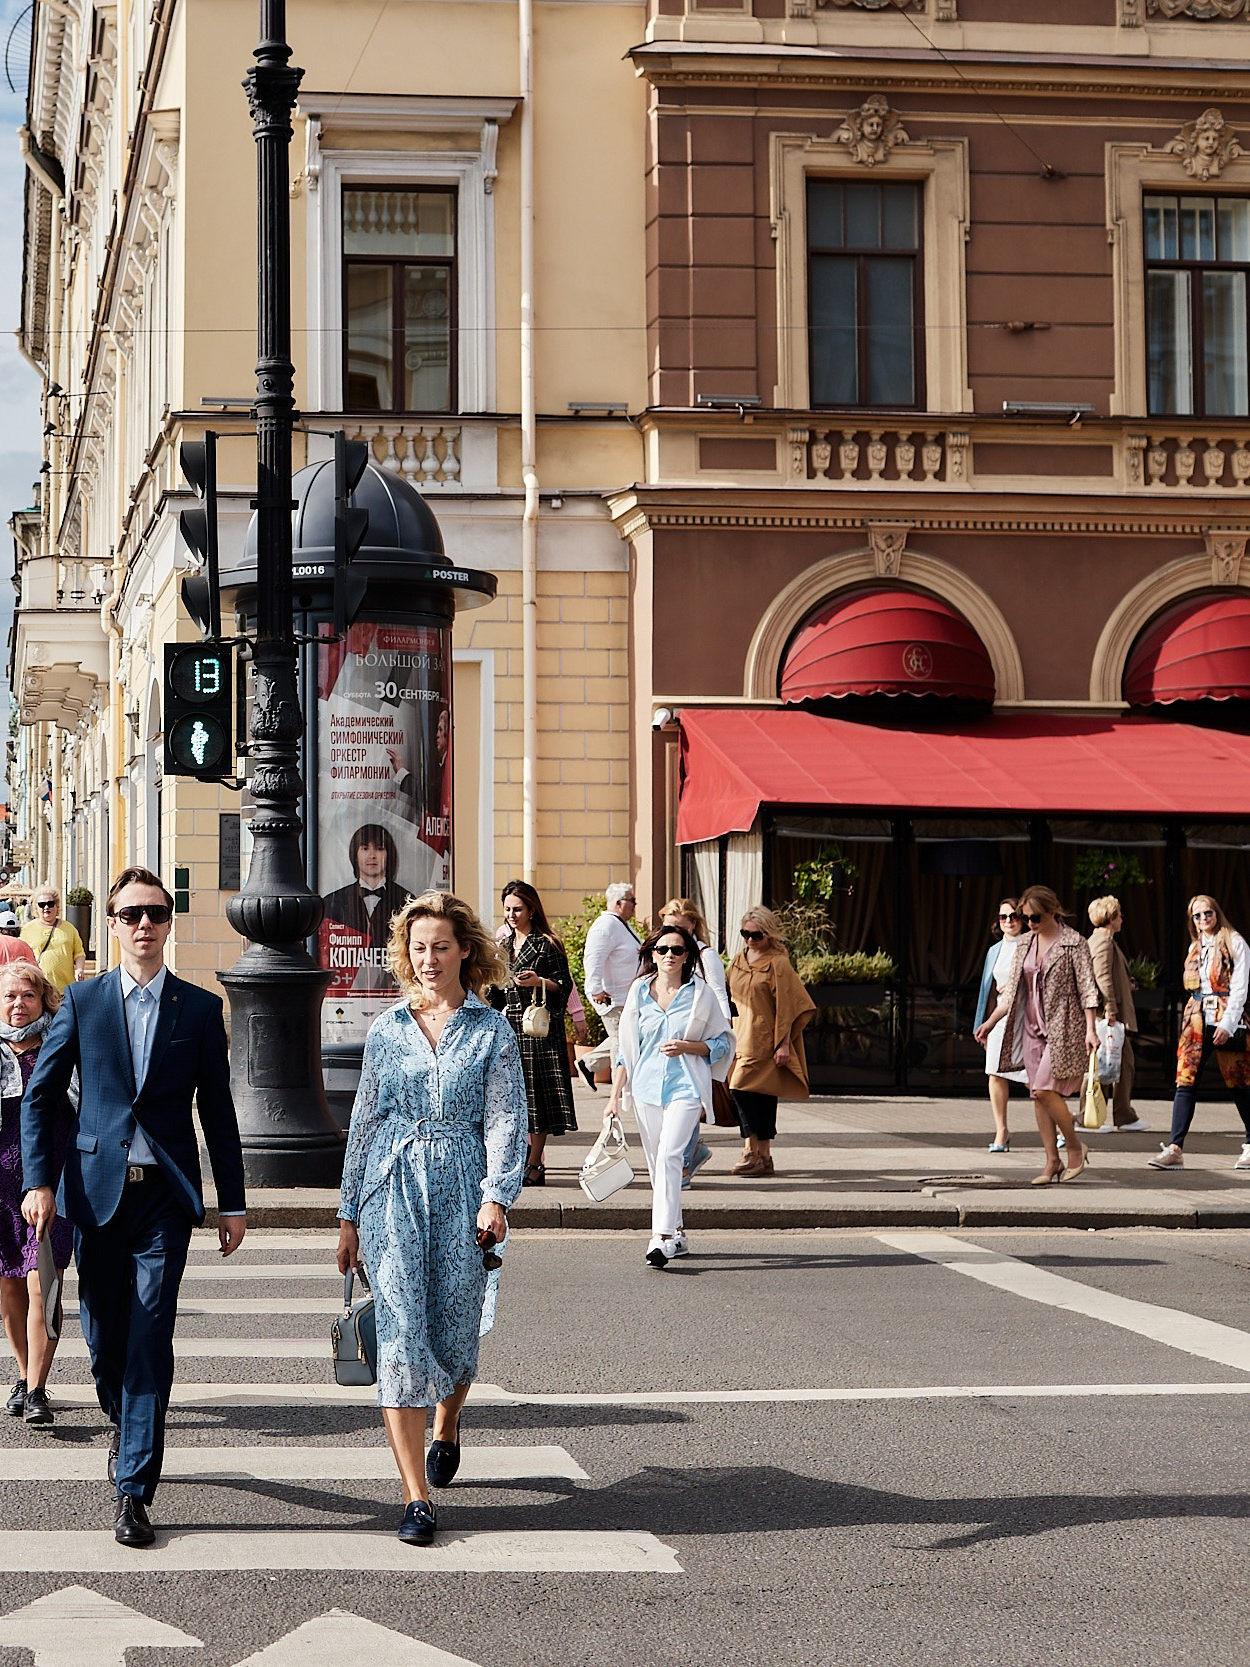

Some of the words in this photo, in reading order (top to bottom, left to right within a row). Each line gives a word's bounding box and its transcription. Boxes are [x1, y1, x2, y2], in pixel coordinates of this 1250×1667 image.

[292, 566, 325, 576] L0016
[432, 569, 469, 582] POSTER
[383, 635, 435, 647] ФИЛАРМОНИЯ
[356, 653, 431, 669] БОЛЬШОЙ
[194, 658, 221, 694] 13
[343, 691, 372, 699] СУББОТА
[374, 681, 398, 699] 30
[398, 688, 440, 701] СЕНТЯБРЯ
[330, 714, 394, 728] Академический
[330, 730, 404, 745] СИМФОНИЧЕСКИЙ
[330, 748, 367, 762] ОРКЕСТР
[330, 766, 390, 780] ФИЛАРМОНИИ
[331, 791, 356, 800] ОТКРЫТИЕ
[356, 791, 374, 800] СЕЗОНА
[329, 932, 363, 946] Филипп
